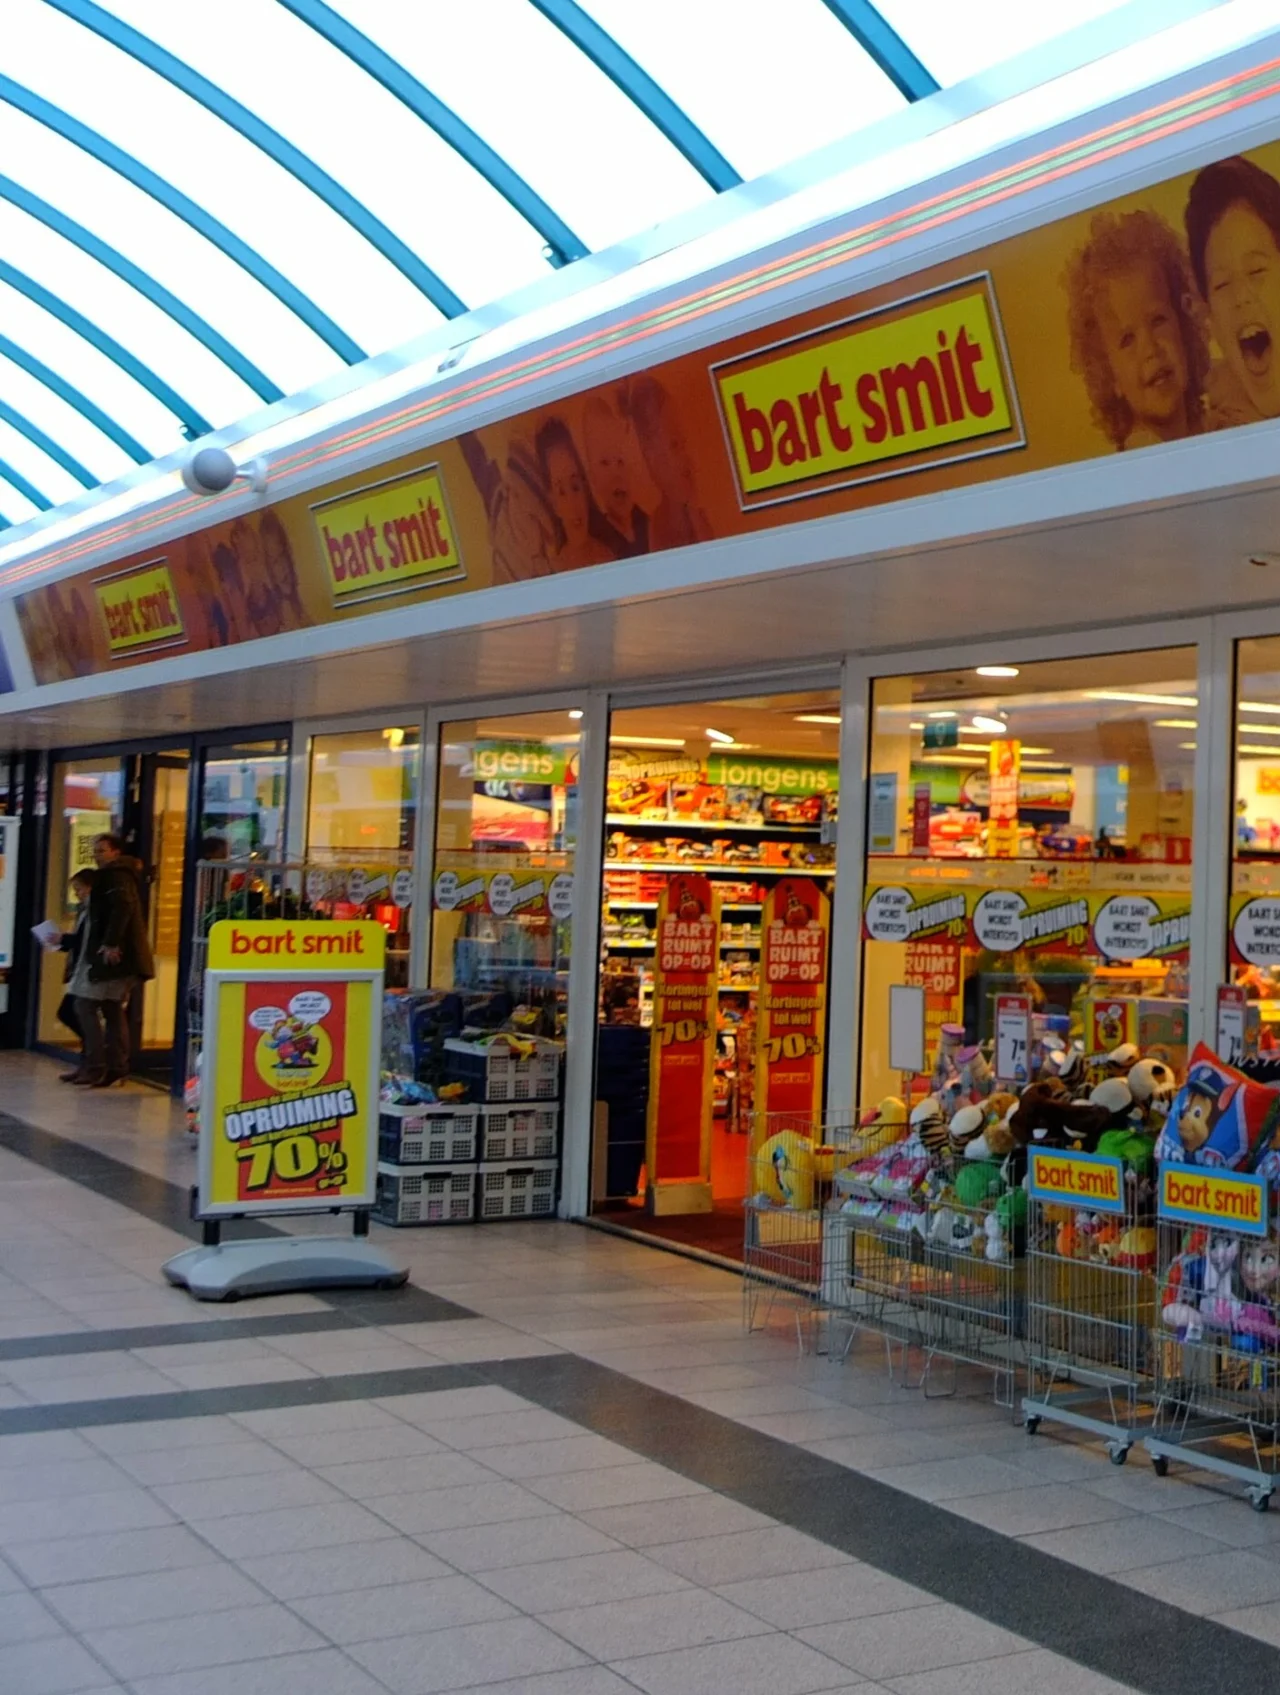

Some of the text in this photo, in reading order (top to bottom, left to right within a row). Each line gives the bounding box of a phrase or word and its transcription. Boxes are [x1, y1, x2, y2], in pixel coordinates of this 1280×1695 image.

[732, 325, 994, 475] bart smit
[321, 496, 450, 582] bart smit
[100, 583, 178, 640] bart smit
[474, 749, 554, 775] gens
[720, 758, 829, 793] jongens
[230, 930, 365, 955] bart smit
[664, 922, 714, 937] BART
[770, 929, 822, 945] BART
[663, 939, 713, 953] RUIMT
[769, 946, 821, 962] RUIMT
[768, 963, 821, 980] OP=OP
[764, 995, 823, 1011] Kortingen
[657, 1019, 712, 1047] 70%
[762, 1033, 822, 1063] 70%
[225, 1088, 356, 1141] OPRUIMING
[235, 1134, 346, 1189] 70%
[1037, 1159, 1117, 1197] bart smit
[1168, 1179, 1259, 1218] bart smit
